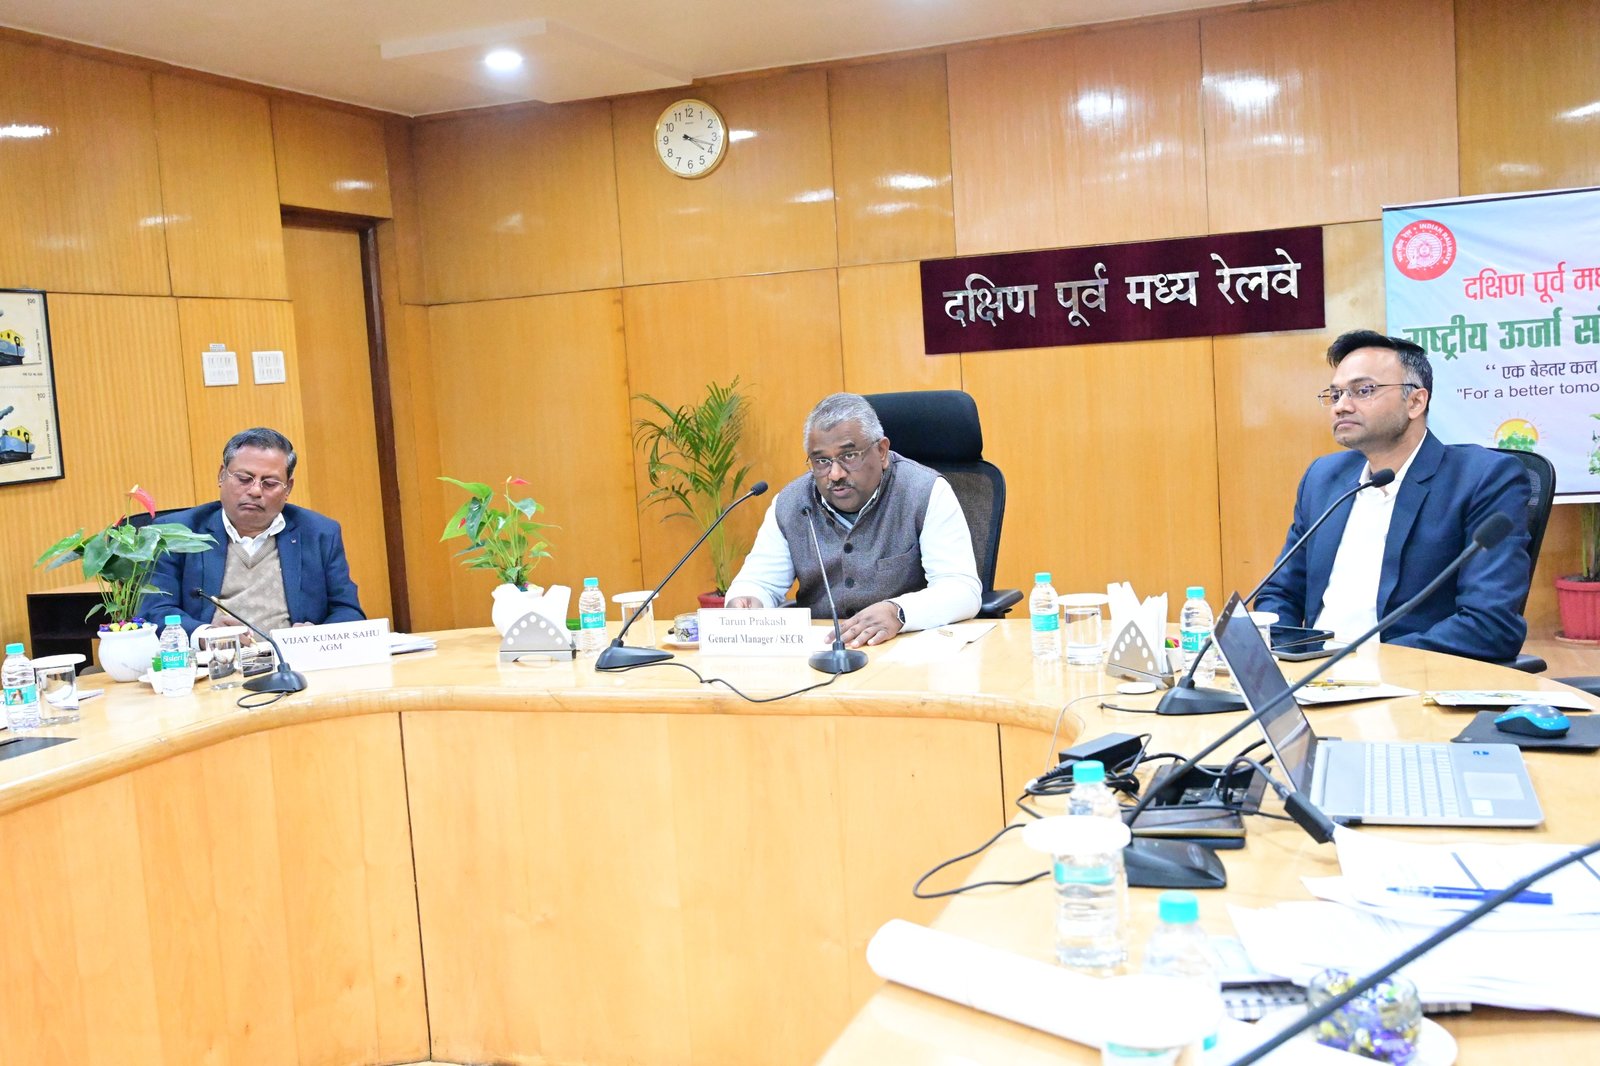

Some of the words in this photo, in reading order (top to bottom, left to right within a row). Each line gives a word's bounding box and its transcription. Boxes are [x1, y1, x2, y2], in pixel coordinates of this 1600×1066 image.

[674, 112, 681, 122] 11
[685, 108, 694, 118] 12
[666, 123, 674, 132] 10
[707, 119, 713, 128] 2
[663, 136, 669, 145] 9
[712, 132, 717, 142] 3
[667, 148, 673, 157] 8
[707, 146, 713, 154] 4
[676, 157, 681, 166] 7
[688, 160, 693, 169] 6
[700, 156, 705, 165] 5
[1419, 224, 1444, 234] INDIAN
[942, 272, 1038, 327] दक्षिण
[1054, 262, 1109, 326] पूर्व
[1124, 271, 1199, 310] मध्य
[1210, 248, 1302, 304] रेलवे
[1462, 268, 1526, 300] दक्षिण
[1532, 262, 1566, 303] पूर्व
[1498, 306, 1562, 350] ऊर्जा
[1502, 365, 1526, 379] एक
[1530, 360, 1566, 377] बेहतर
[1569, 360, 1598, 374] कल
[1457, 388, 1489, 400] "For
[1494, 389, 1503, 398] a
[1509, 385, 1554, 397] better
[719, 617, 746, 626] Tarun
[749, 617, 786, 626] Prakash
[282, 636, 310, 645] VIJAY
[312, 632, 350, 642] KUMAR
[353, 629, 380, 639] SAHU
[708, 634, 738, 643] General
[740, 634, 774, 645] Manager
[780, 634, 804, 644] SECR
[319, 643, 342, 652] AGM
